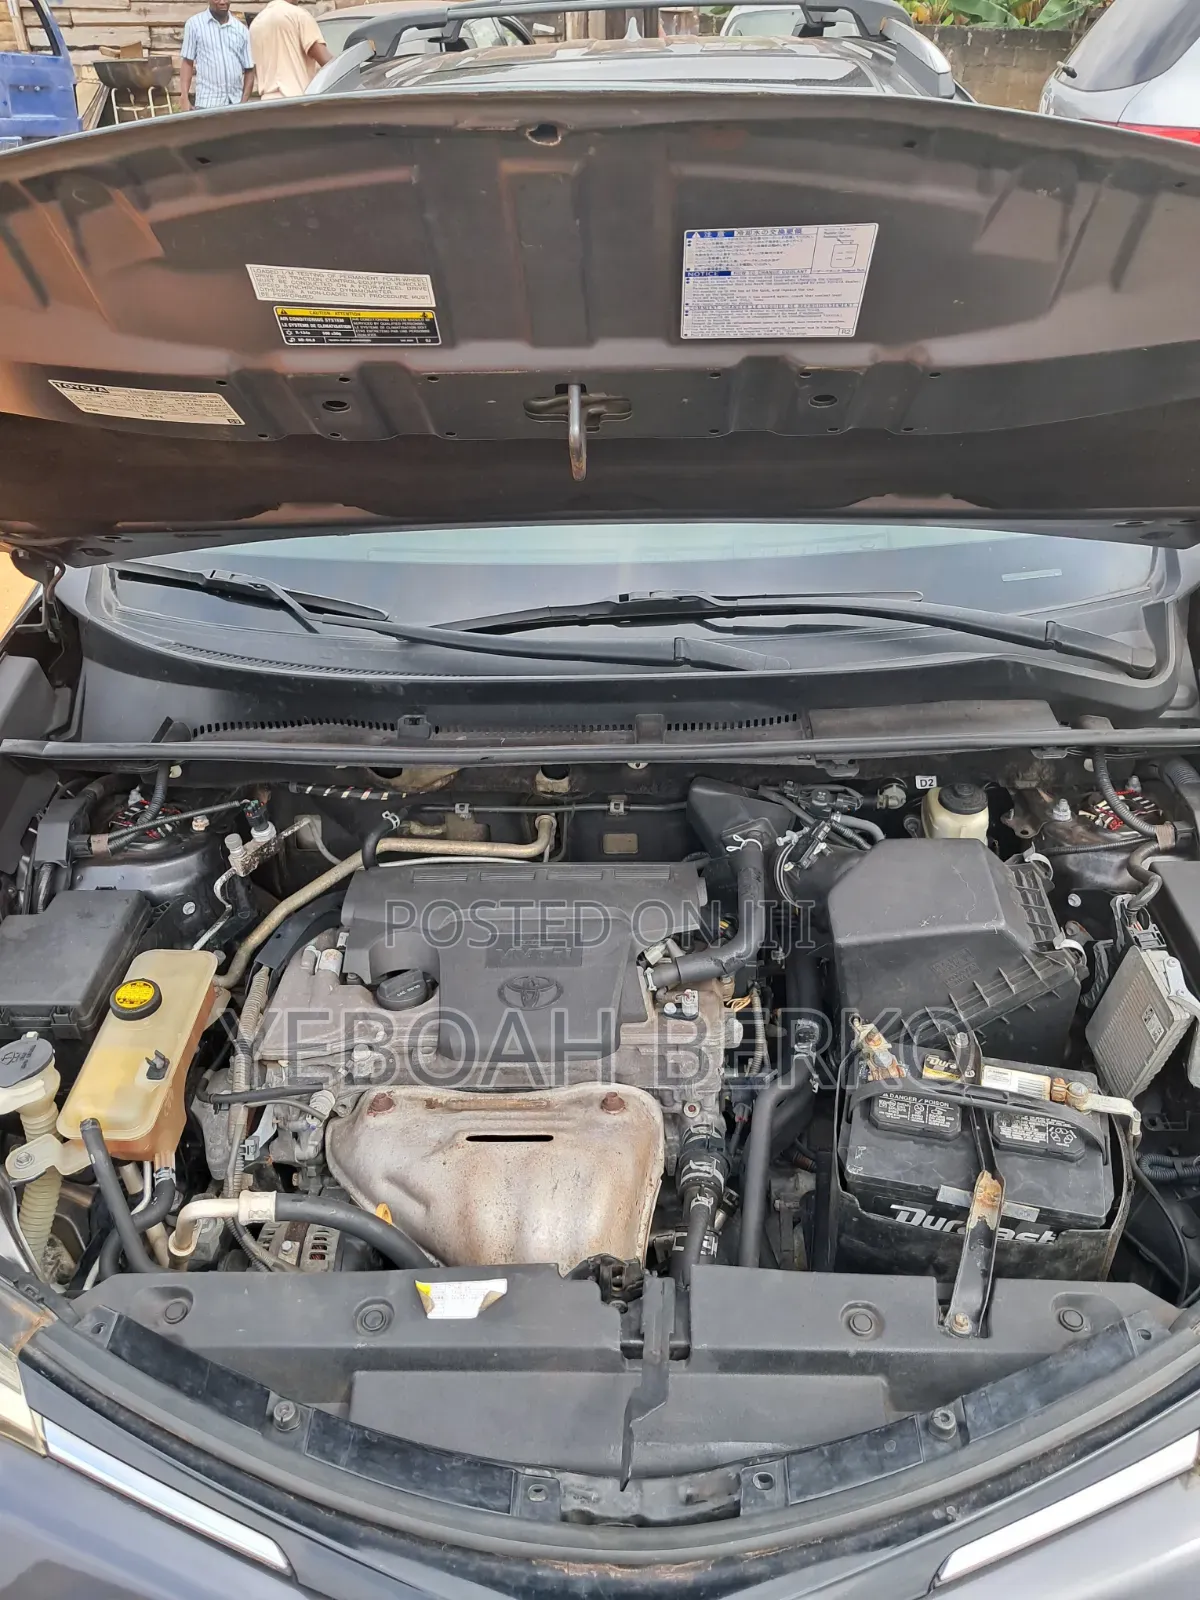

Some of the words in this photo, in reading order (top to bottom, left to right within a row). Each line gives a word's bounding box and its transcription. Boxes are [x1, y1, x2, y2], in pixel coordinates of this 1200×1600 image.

[55, 382, 109, 393] TOYOTA
[920, 779, 934, 787] D2
[926, 1056, 957, 1070] Dura
[890, 1094, 917, 1102] DANGER
[924, 1099, 949, 1107] POISON
[890, 1204, 1056, 1244] Durast
